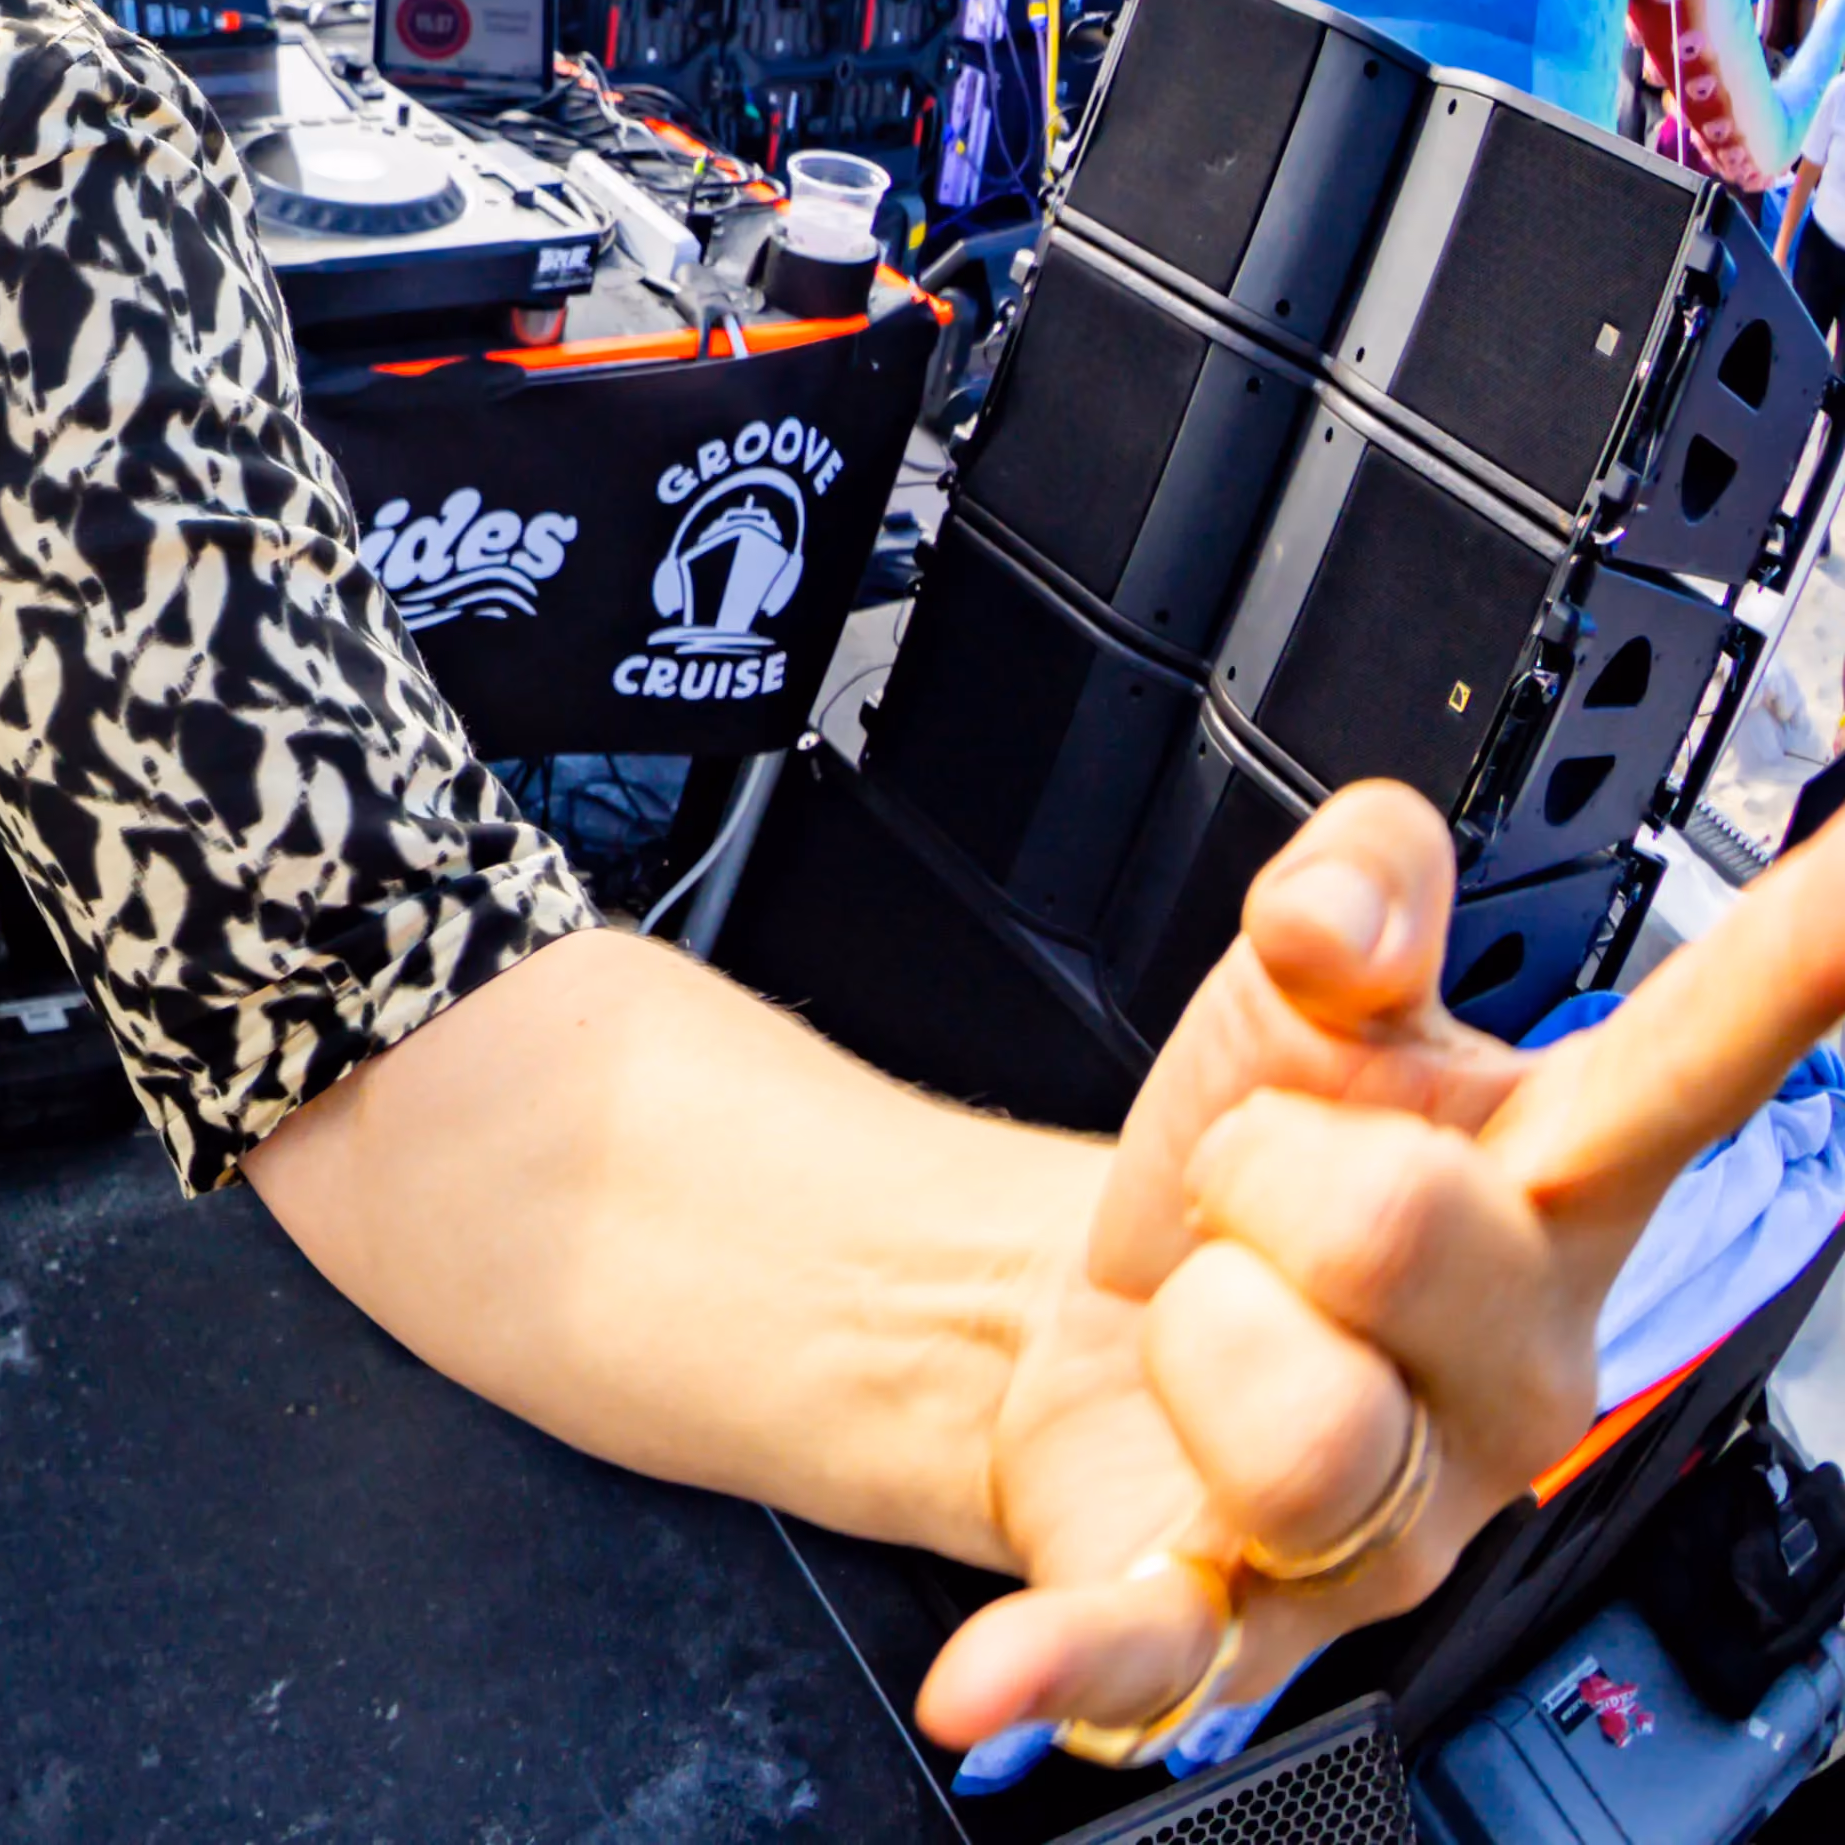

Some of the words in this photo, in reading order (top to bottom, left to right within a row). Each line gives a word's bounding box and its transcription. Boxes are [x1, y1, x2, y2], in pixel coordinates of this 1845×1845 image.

[656, 415, 844, 505] GROOVE
[359, 486, 579, 591] ides
[612, 650, 788, 701] CRUISE
